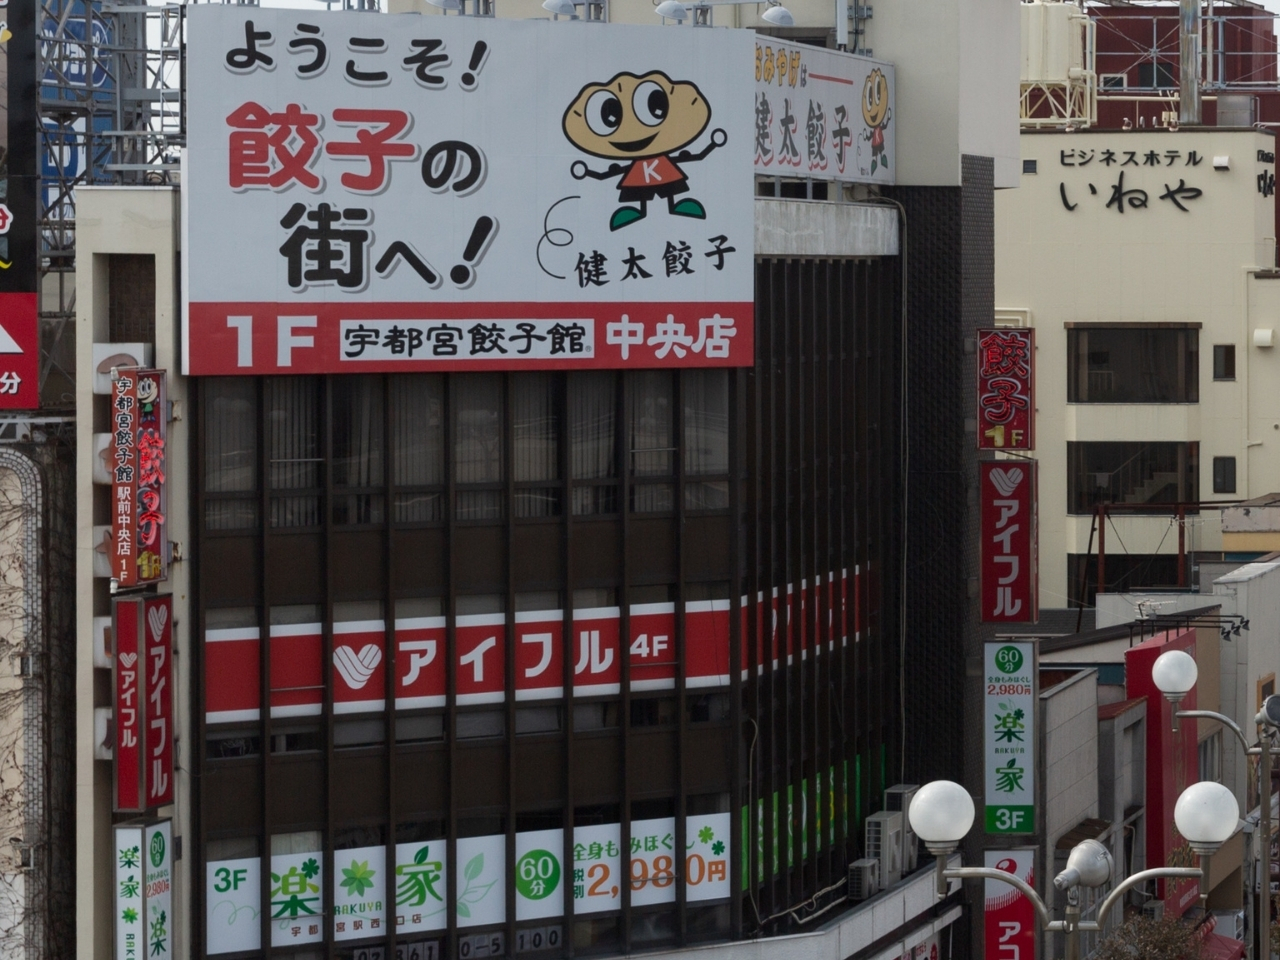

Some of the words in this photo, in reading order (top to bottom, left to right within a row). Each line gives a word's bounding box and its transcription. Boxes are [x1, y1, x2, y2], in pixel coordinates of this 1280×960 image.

[225, 20, 489, 90] ようこそ!
[226, 100, 484, 193] 餃子の
[1060, 149, 1203, 167] ビジネスホテル
[1060, 170, 1203, 214] いねや
[279, 202, 498, 289] 街へ!
[574, 233, 738, 289] 健太餃子
[228, 315, 318, 367] 1F
[344, 322, 591, 359] 宇都宮餃子館
[606, 314, 736, 360] 中央店
[979, 331, 1030, 425] 餃子
[115, 377, 133, 483] 宇都宮餃子館
[117, 486, 131, 556] 駅前中央店
[992, 499, 1022, 617] アイフル
[398, 631, 613, 686] アイフル
[630, 632, 669, 659] 4F
[121, 670, 138, 748] アイフル
[150, 644, 169, 798] アイフル
[995, 808, 1024, 831] 3F
[214, 867, 248, 893] 3F
[334, 900, 383, 916] RAKUYA
